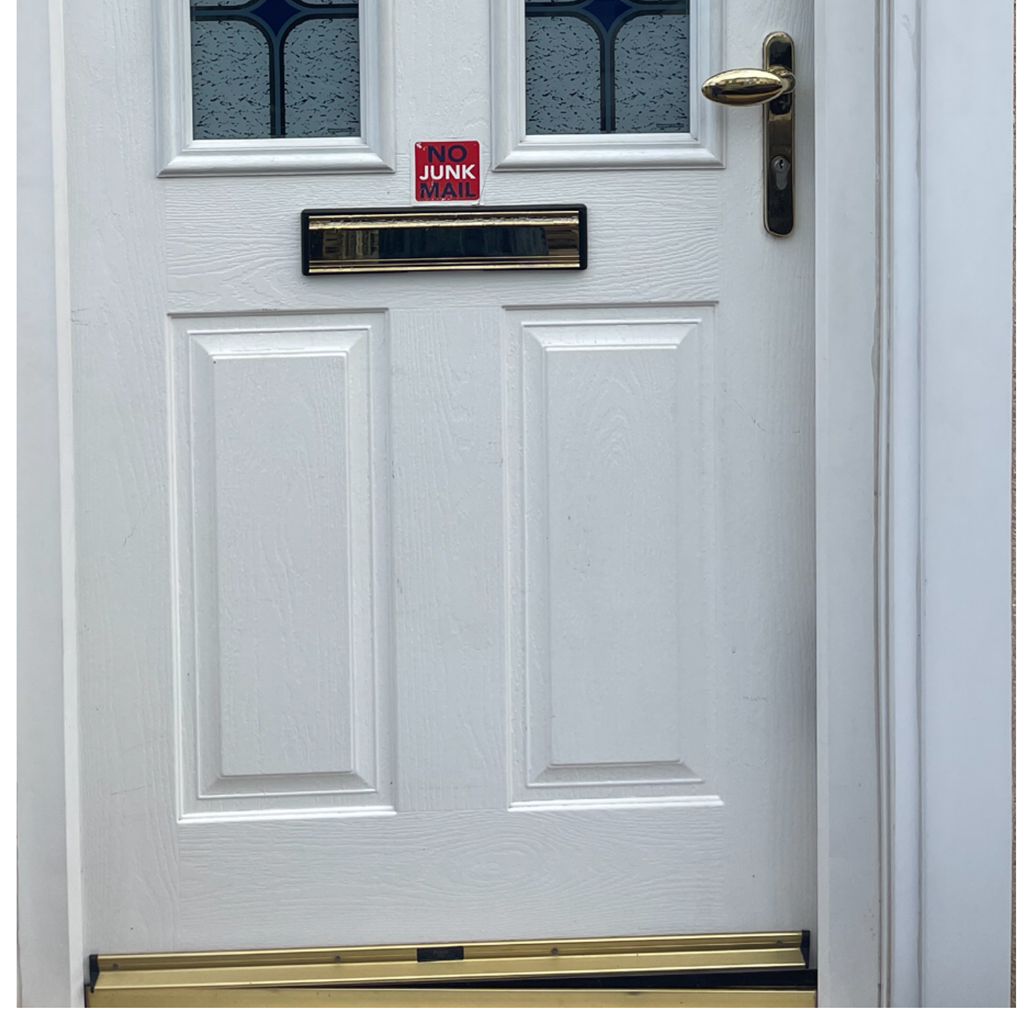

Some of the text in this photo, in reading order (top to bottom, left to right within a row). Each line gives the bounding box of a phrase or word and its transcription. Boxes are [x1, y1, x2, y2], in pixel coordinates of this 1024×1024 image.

[428, 144, 468, 163] NO
[419, 164, 476, 180] JUNK
[420, 182, 477, 199] MAIL
